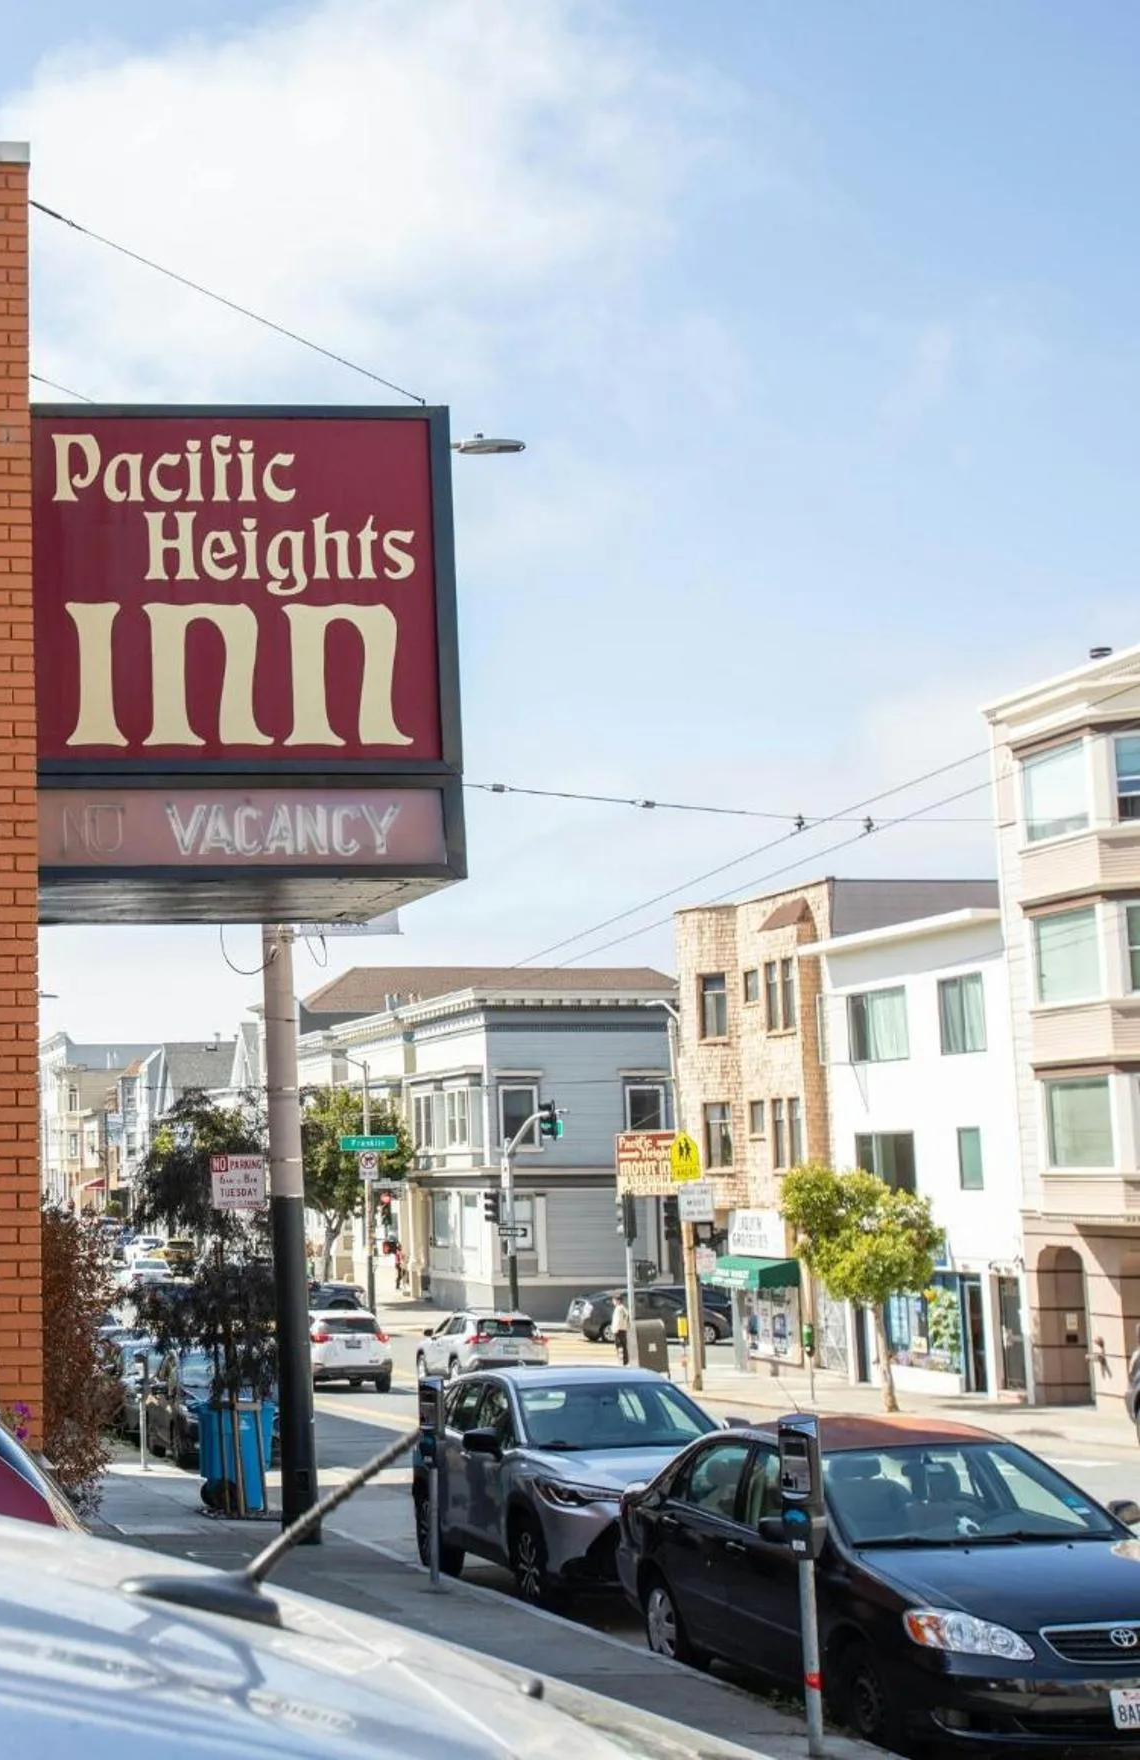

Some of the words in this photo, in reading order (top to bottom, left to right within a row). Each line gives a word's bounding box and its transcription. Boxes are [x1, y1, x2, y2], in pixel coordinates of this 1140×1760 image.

[51, 433, 297, 502] Pacific
[143, 511, 416, 596] Heights
[165, 802, 398, 856] VACANCY
[212, 1157, 227, 1171] NO
[230, 1160, 262, 1170] PARKING
[220, 1188, 258, 1198] TUESDAY
